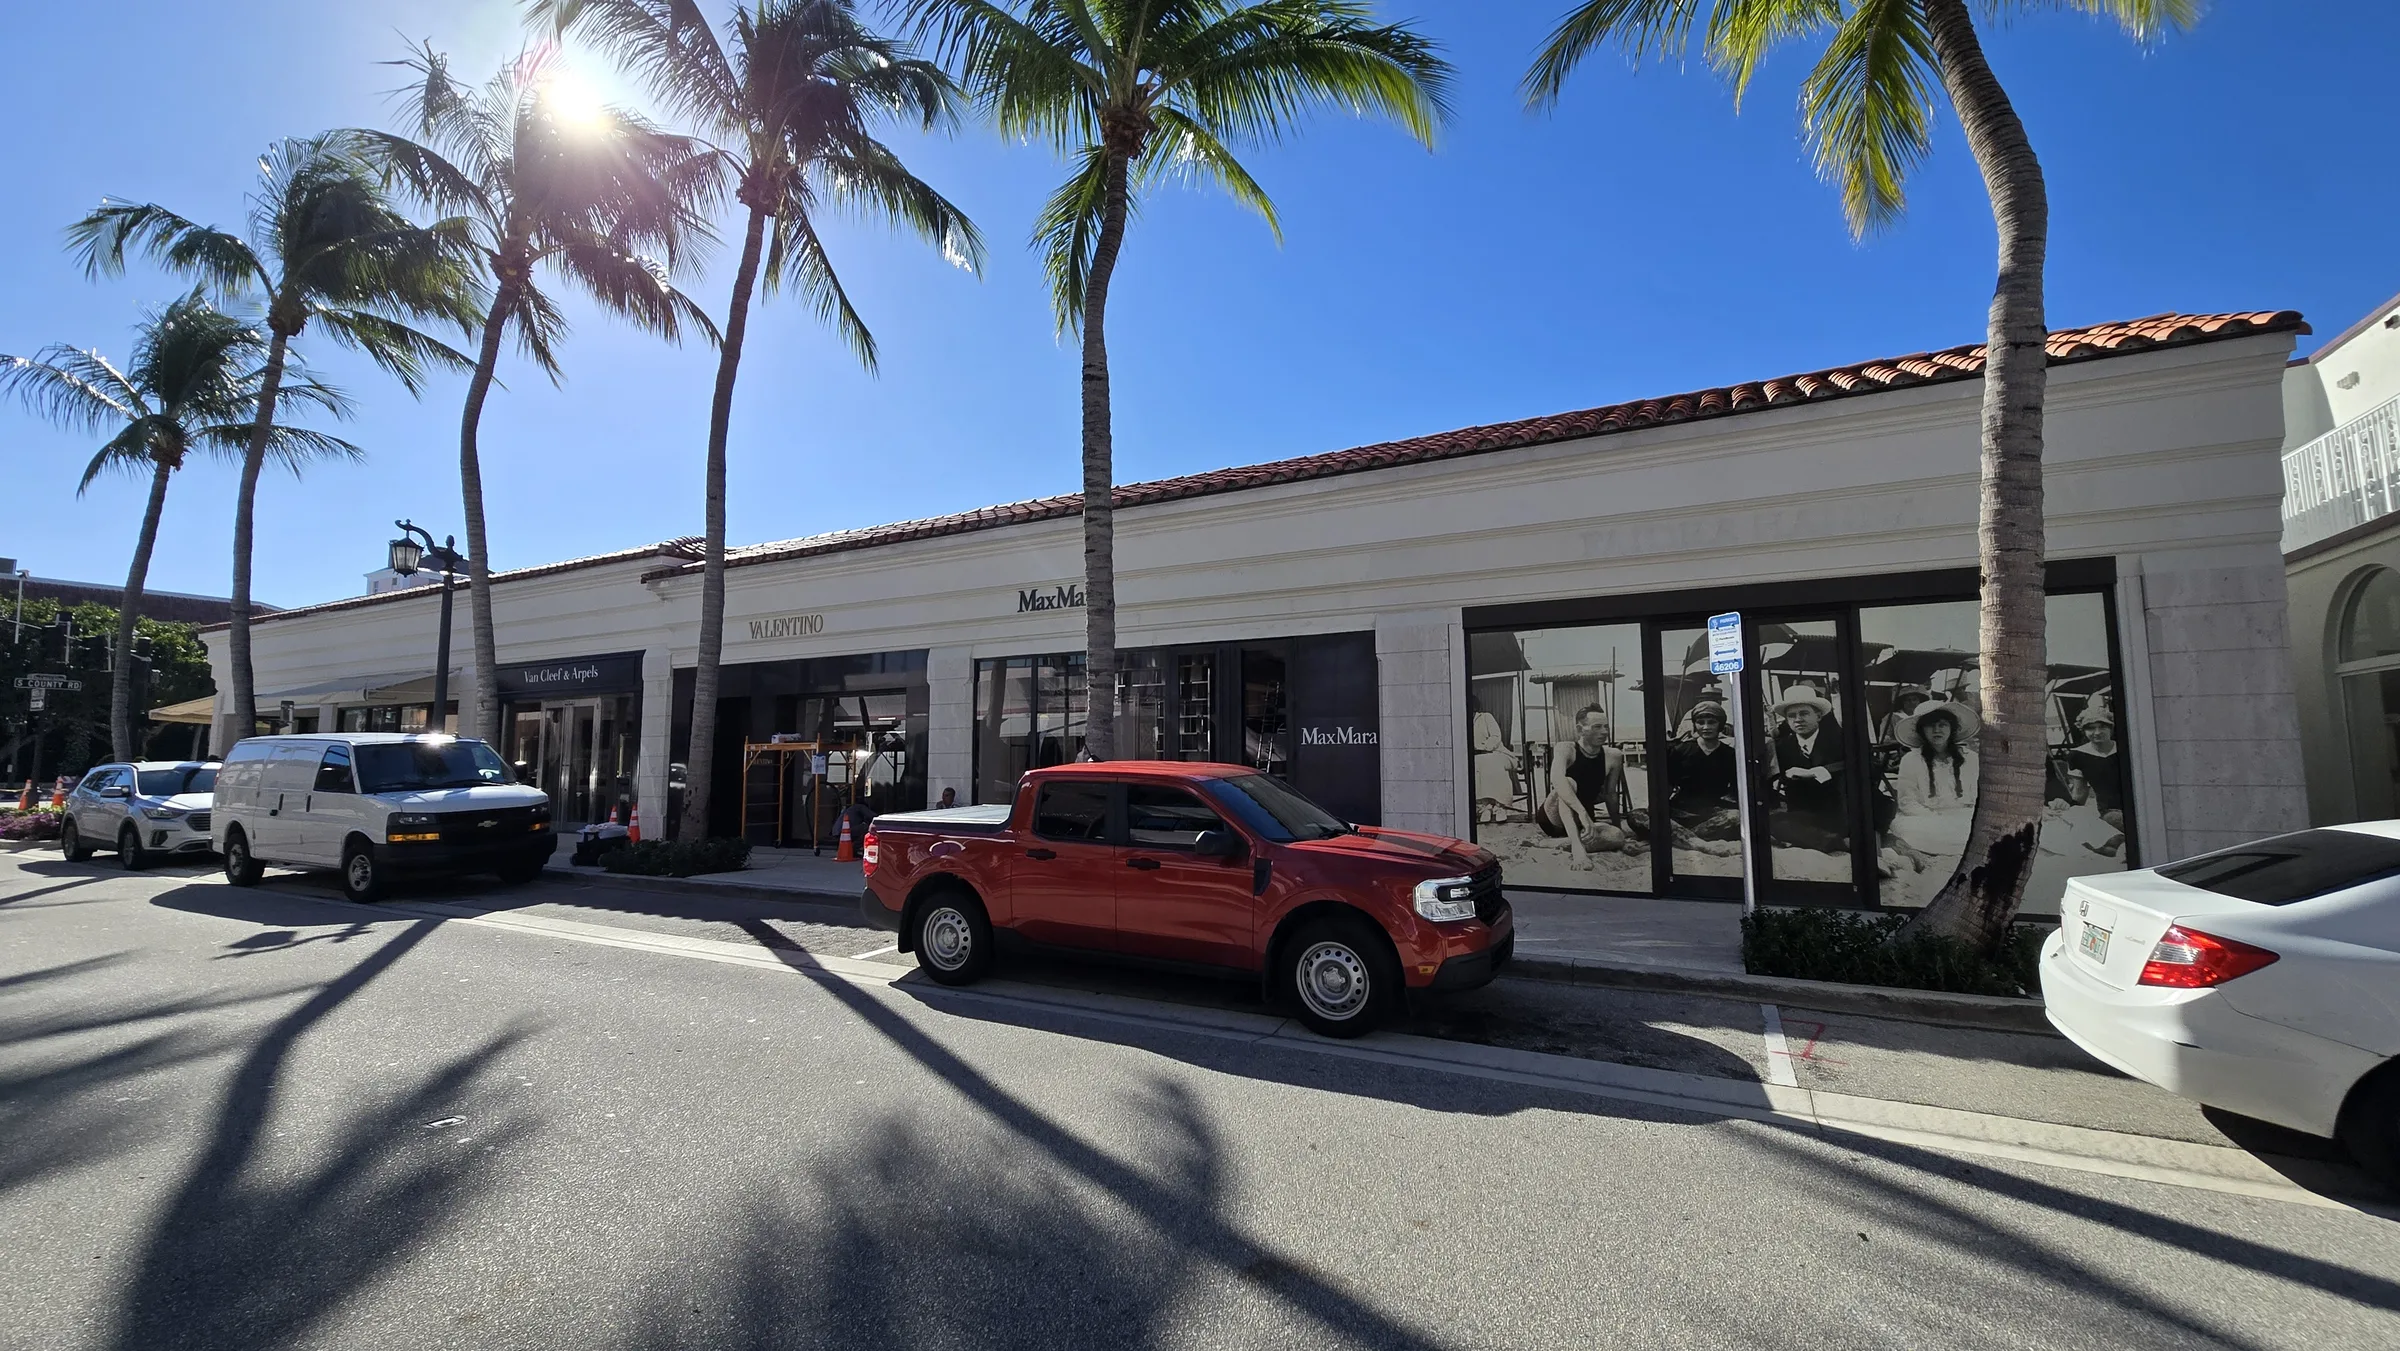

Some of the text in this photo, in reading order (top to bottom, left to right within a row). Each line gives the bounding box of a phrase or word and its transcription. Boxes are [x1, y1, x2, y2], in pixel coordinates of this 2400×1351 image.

[1017, 584, 1087, 613] MaxMa
[748, 614, 824, 640] VALENTINO
[524, 664, 599, 683] Van Cleef & Arpels
[17, 679, 23, 687] S
[28, 680, 63, 688] COUNTY
[1300, 726, 1378, 745] MaxMara
